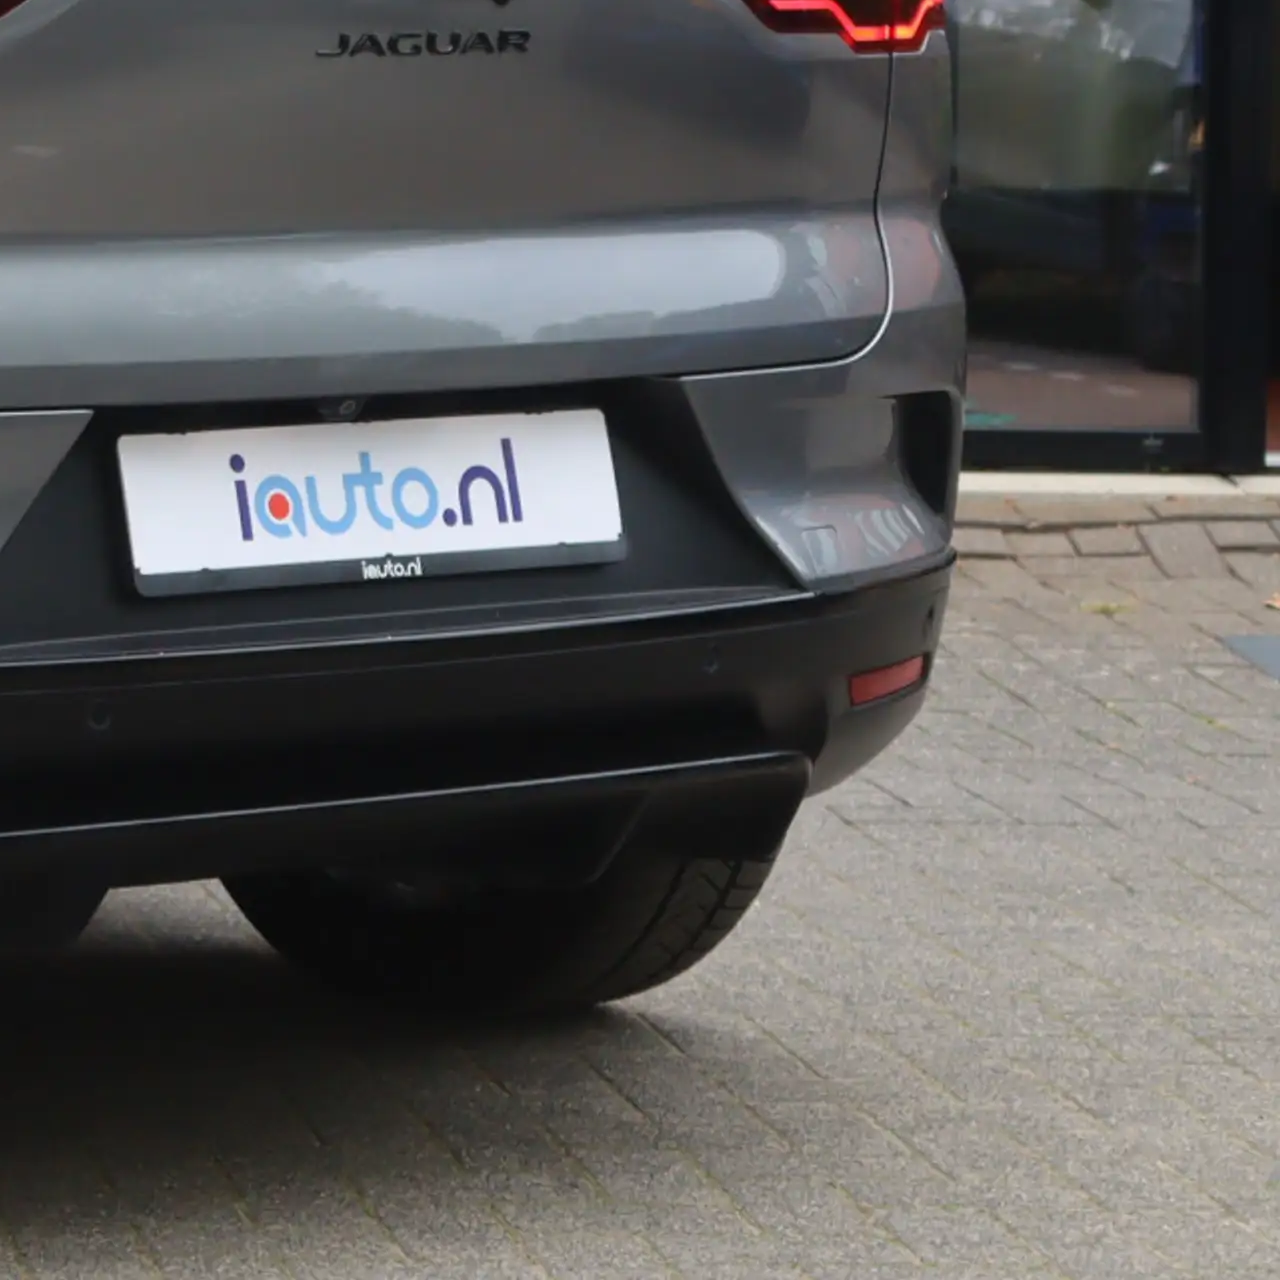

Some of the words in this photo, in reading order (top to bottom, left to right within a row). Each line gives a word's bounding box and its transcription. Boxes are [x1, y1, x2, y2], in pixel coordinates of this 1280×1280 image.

[316, 29, 532, 57] JAGUAR
[228, 437, 523, 542] iauto.nl
[361, 556, 422, 579] iauto.nl
